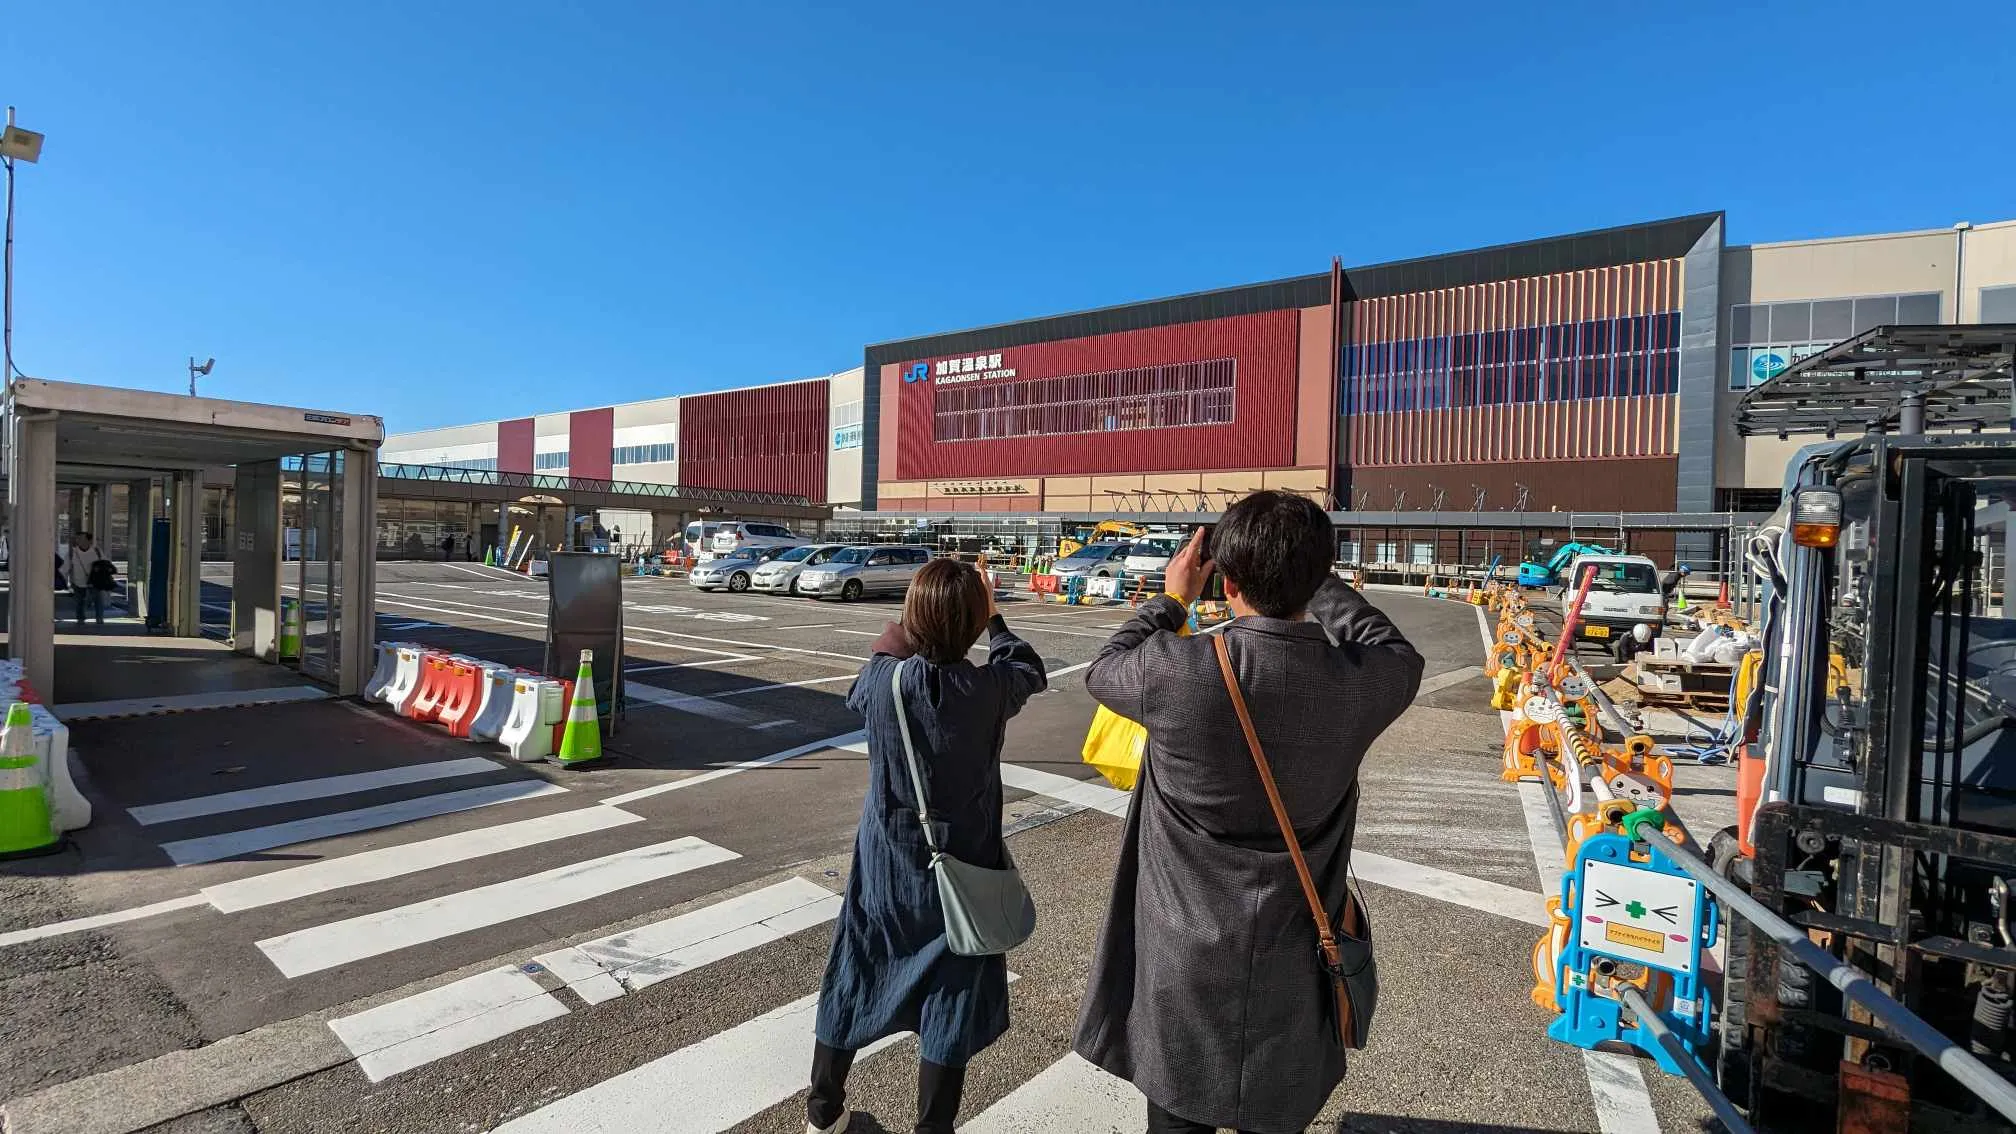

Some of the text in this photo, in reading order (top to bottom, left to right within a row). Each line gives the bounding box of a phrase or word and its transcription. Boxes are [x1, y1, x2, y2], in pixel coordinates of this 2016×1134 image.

[904, 362, 929, 383] JR
[936, 353, 1002, 375] 加賀温泉駅
[936, 368, 1016, 385] KAGAONSEN STATION
